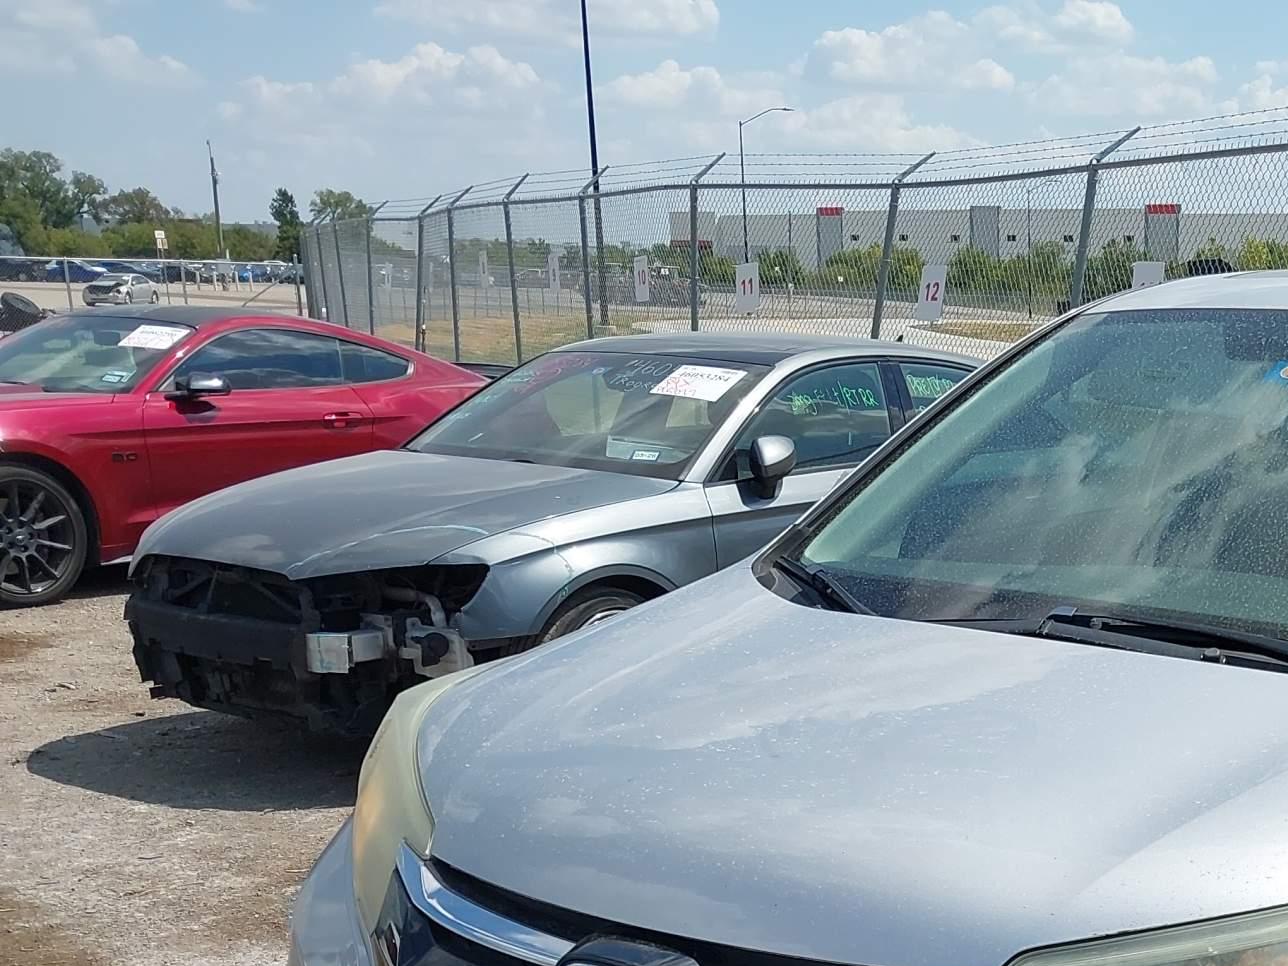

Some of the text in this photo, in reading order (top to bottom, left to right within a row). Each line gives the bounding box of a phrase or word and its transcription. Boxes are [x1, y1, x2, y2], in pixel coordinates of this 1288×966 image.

[637, 270, 646, 285] 10
[741, 278, 753, 296] 11
[925, 281, 940, 301] 12
